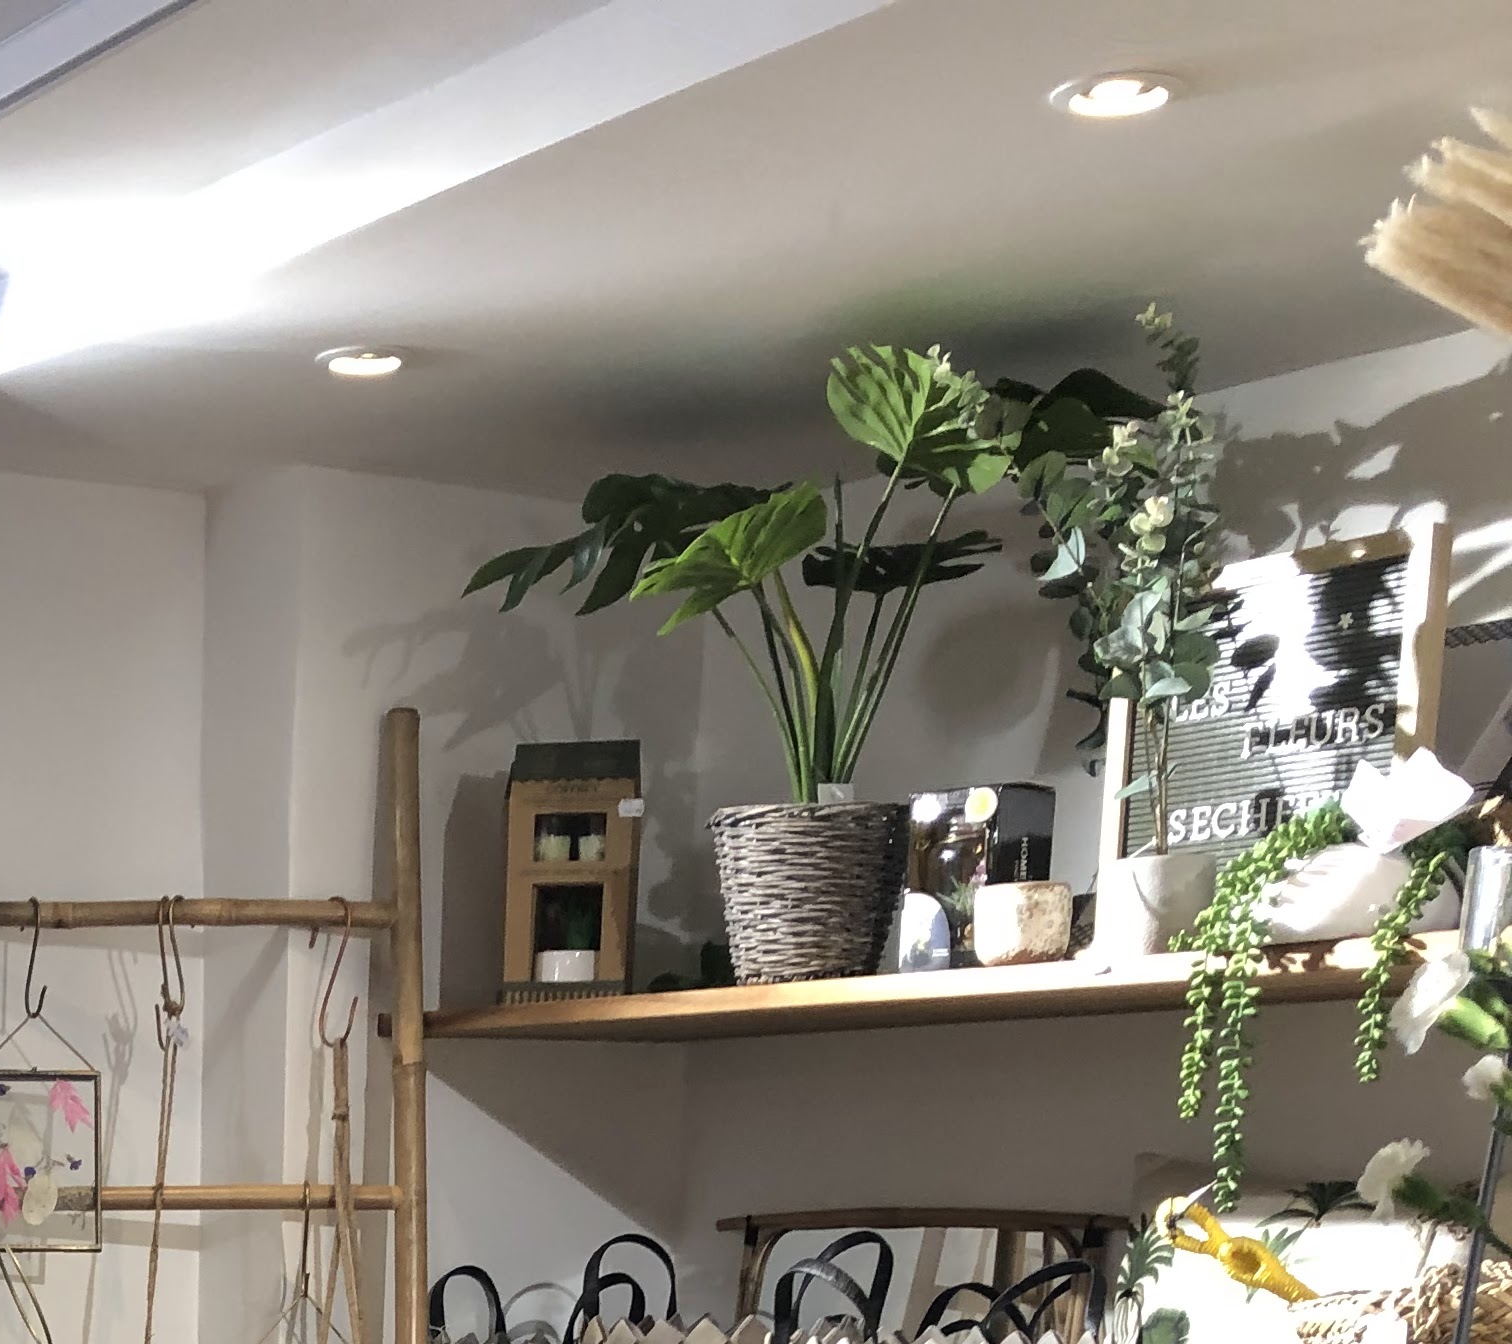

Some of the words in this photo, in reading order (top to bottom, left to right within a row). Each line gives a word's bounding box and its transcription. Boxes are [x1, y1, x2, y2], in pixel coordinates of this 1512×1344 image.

[1240, 702, 1385, 760] FLEURS
[1167, 790, 1341, 846] SECHEE
[1019, 835, 1030, 880] HOME
